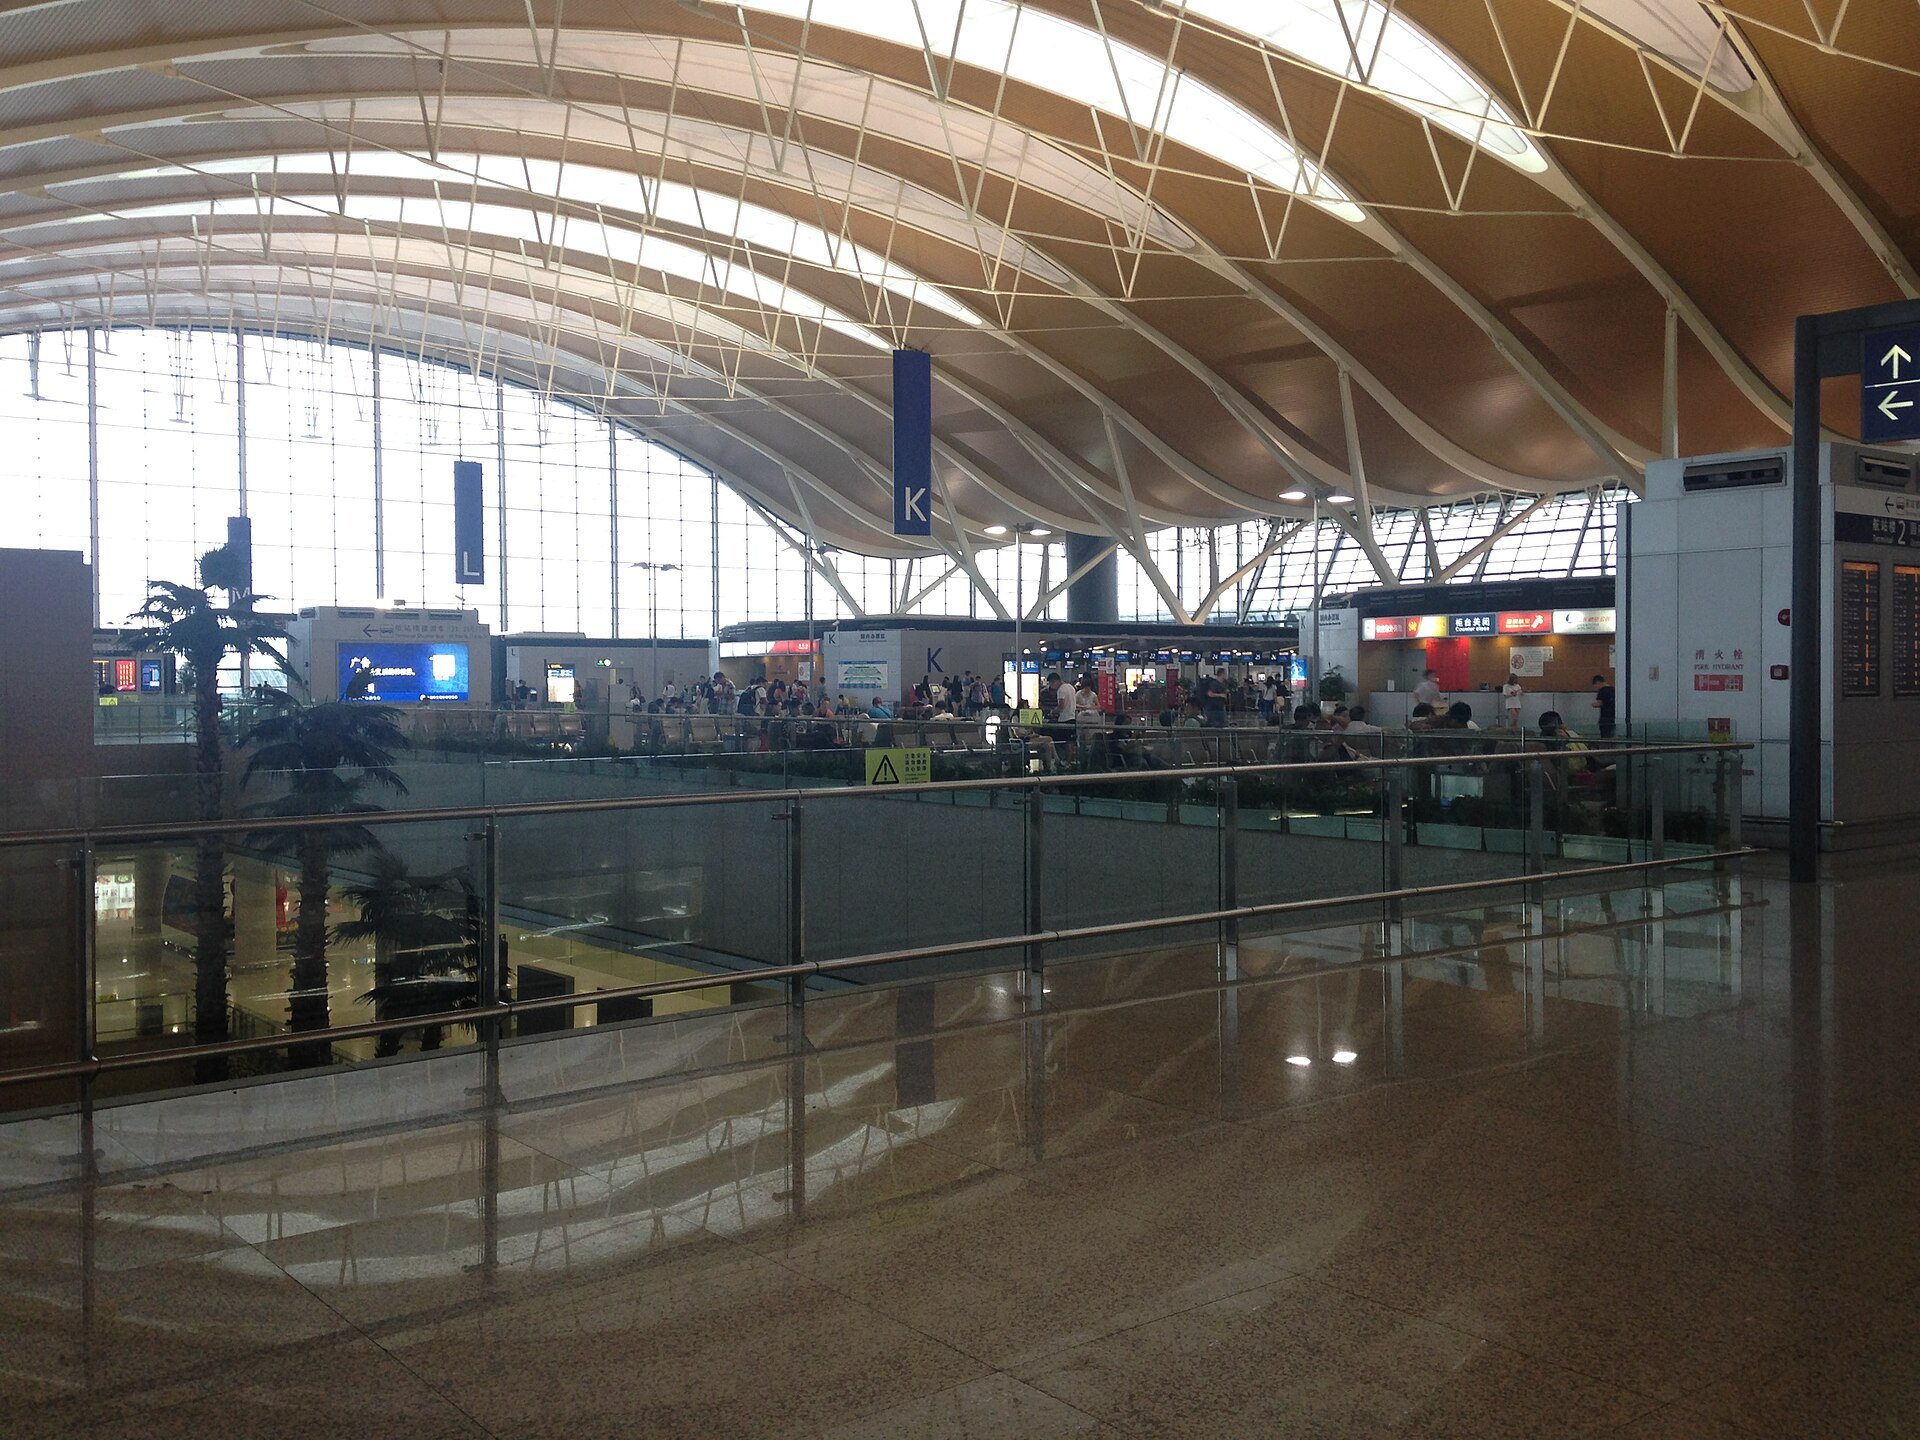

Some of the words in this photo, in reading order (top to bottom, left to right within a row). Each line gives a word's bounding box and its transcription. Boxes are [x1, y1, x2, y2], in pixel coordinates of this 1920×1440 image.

[905, 487, 927, 522] K
[1898, 520, 1906, 544] 2
[463, 551, 480, 576] L
[232, 587, 250, 604] M
[1455, 617, 1490, 627] 柜台关闭
[828, 634, 836, 645] K
[927, 647, 943, 673] K
